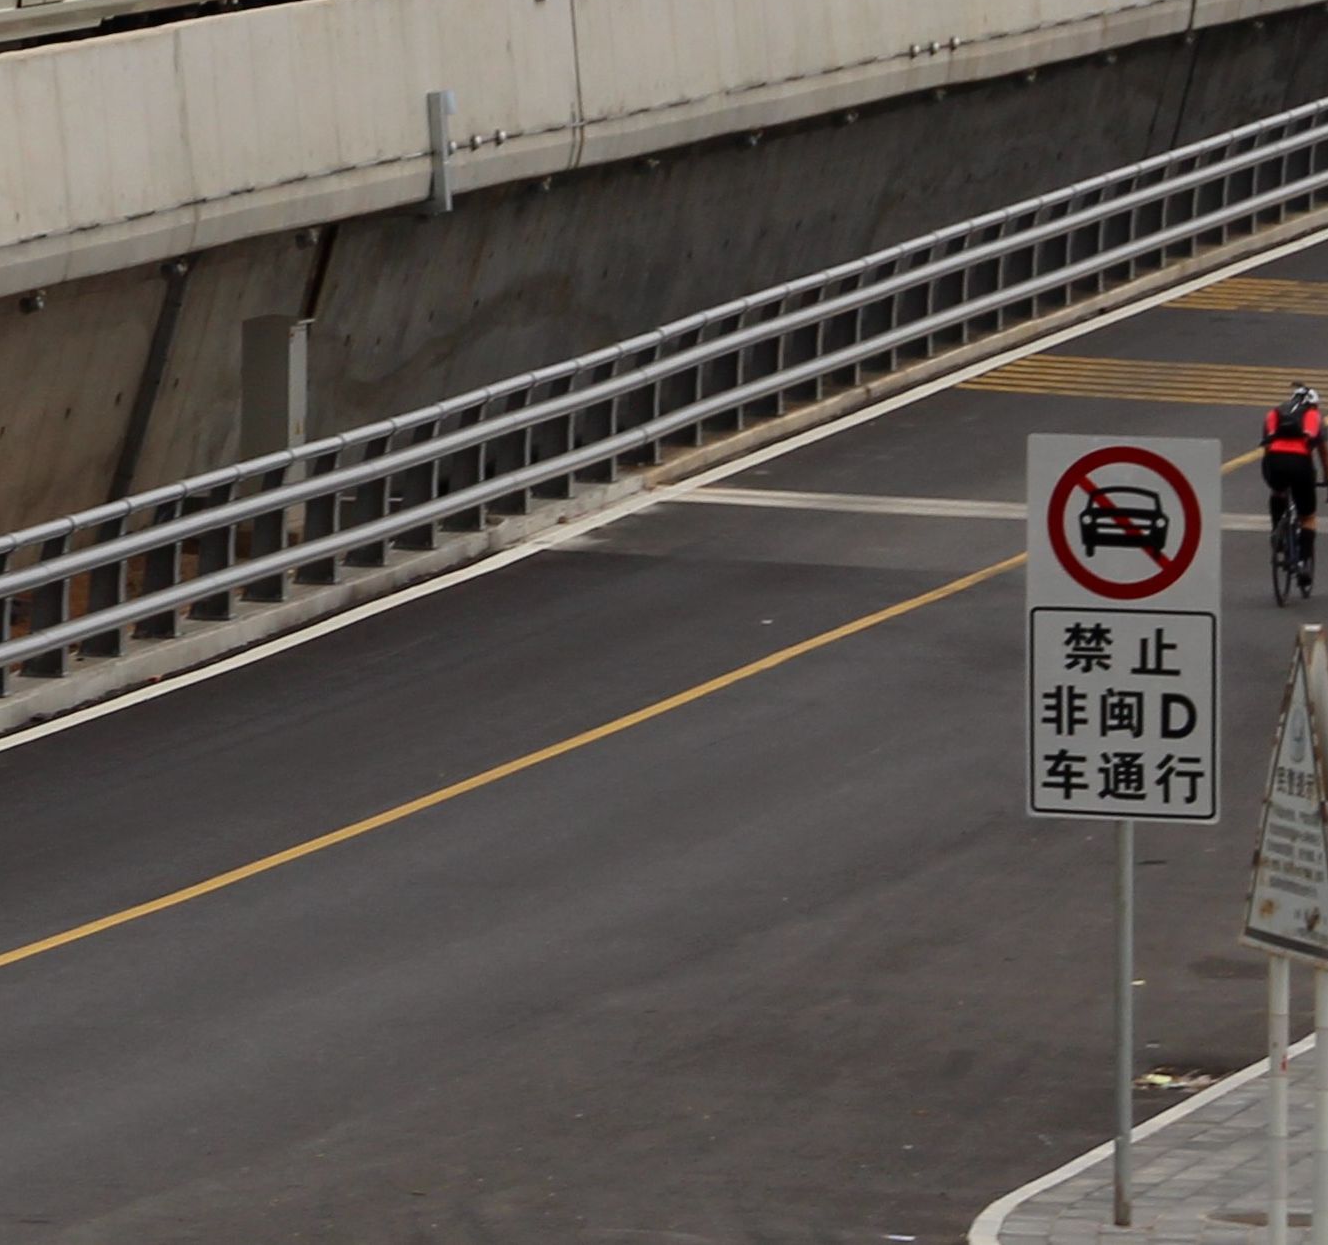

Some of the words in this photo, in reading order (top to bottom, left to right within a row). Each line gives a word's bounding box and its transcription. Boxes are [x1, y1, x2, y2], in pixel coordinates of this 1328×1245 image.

[1063, 621, 1182, 677] 禁止
[1041, 683, 1198, 740] 非闽D
[1041, 748, 1205, 805] 车通行
